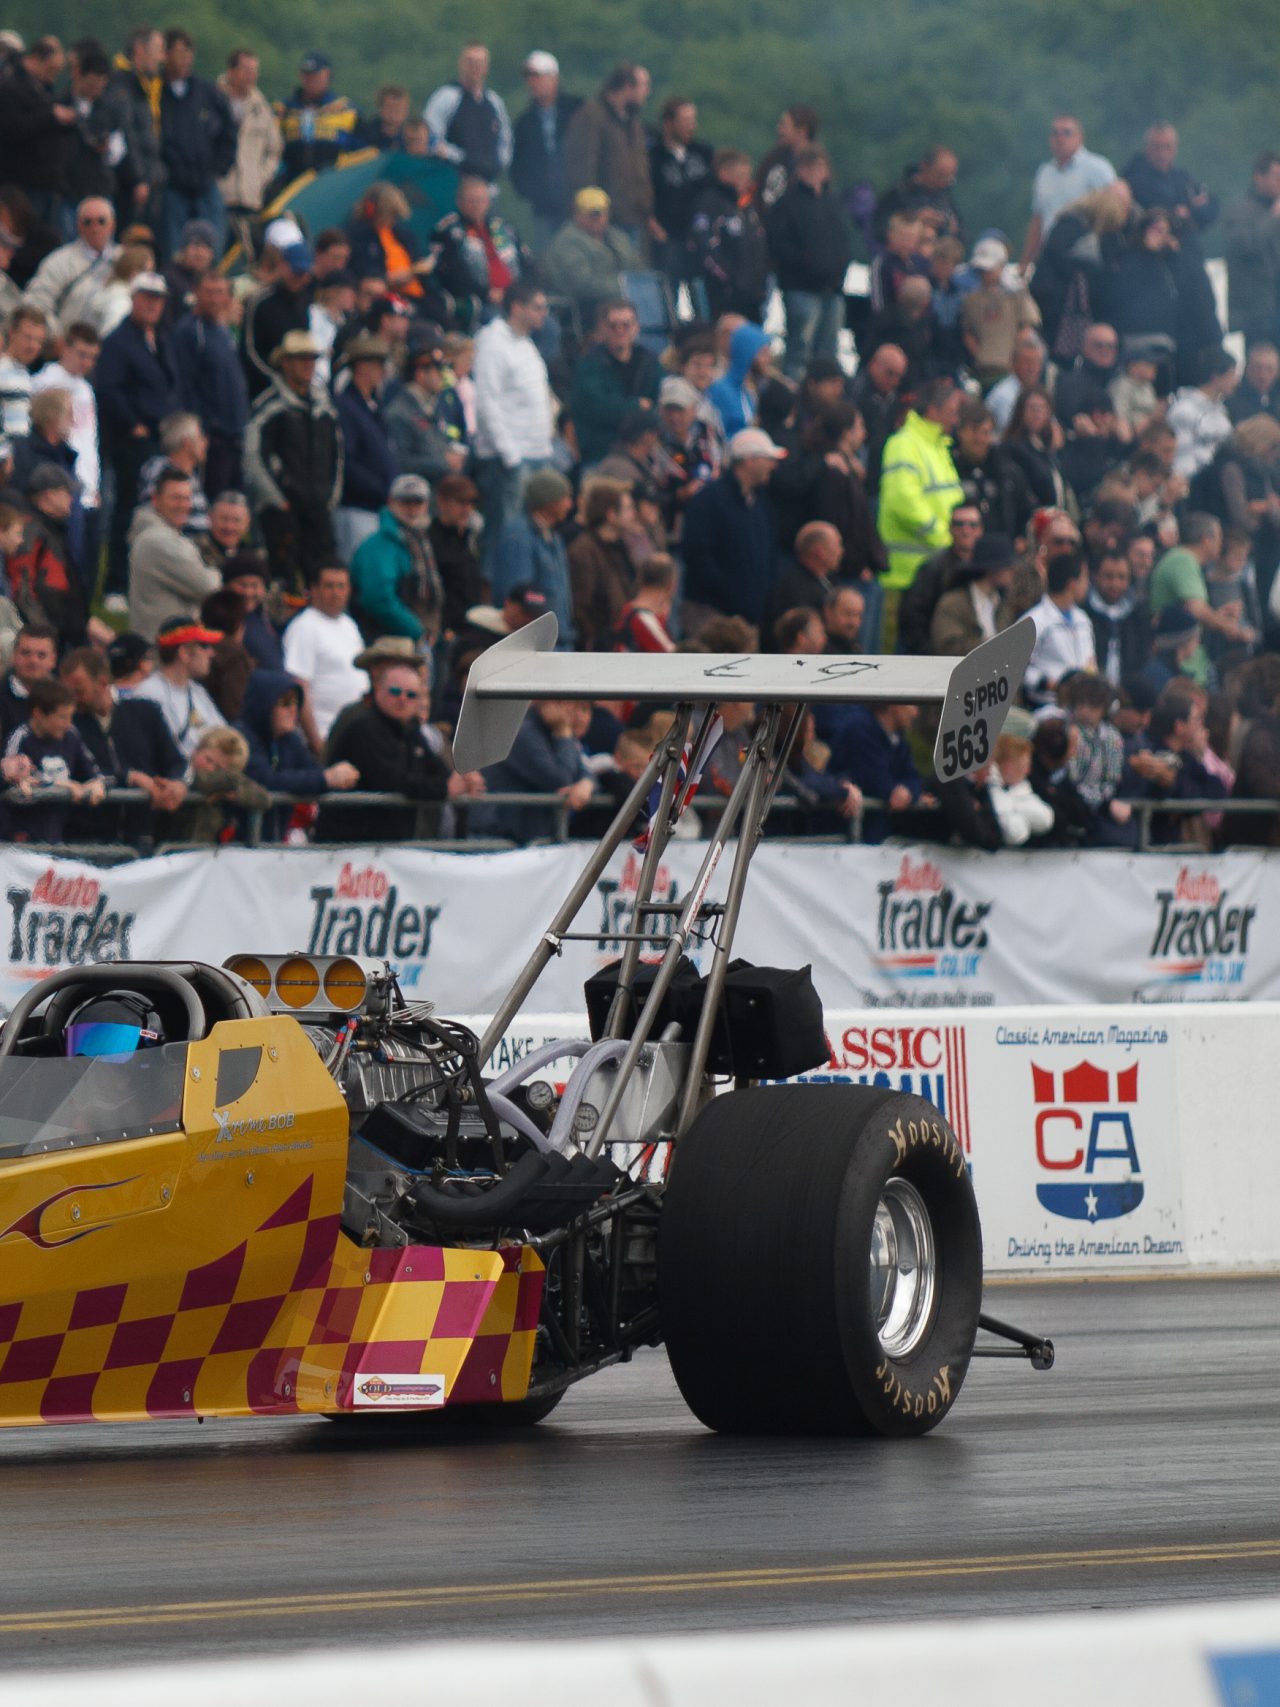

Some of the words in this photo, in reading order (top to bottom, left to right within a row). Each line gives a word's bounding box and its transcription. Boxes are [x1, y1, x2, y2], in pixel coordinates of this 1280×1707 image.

[963, 676, 1008, 717] S/PRO
[942, 718, 989, 777] 563
[335, 862, 389, 899] Auto
[6, 883, 136, 966] Trader
[308, 885, 441, 959] Trader
[877, 880, 992, 951] Trader
[1150, 889, 1256, 958] Trader
[996, 1026, 1039, 1045] Classic
[1042, 1027, 1104, 1045] American
[1107, 1025, 1168, 1051] Magazine
[1035, 1107, 1141, 1174] CA
[1008, 1237, 1052, 1264] Driving
[1055, 1236, 1075, 1256] the
[1078, 1236, 1140, 1256] American
[1143, 1234, 1183, 1255] Dream
